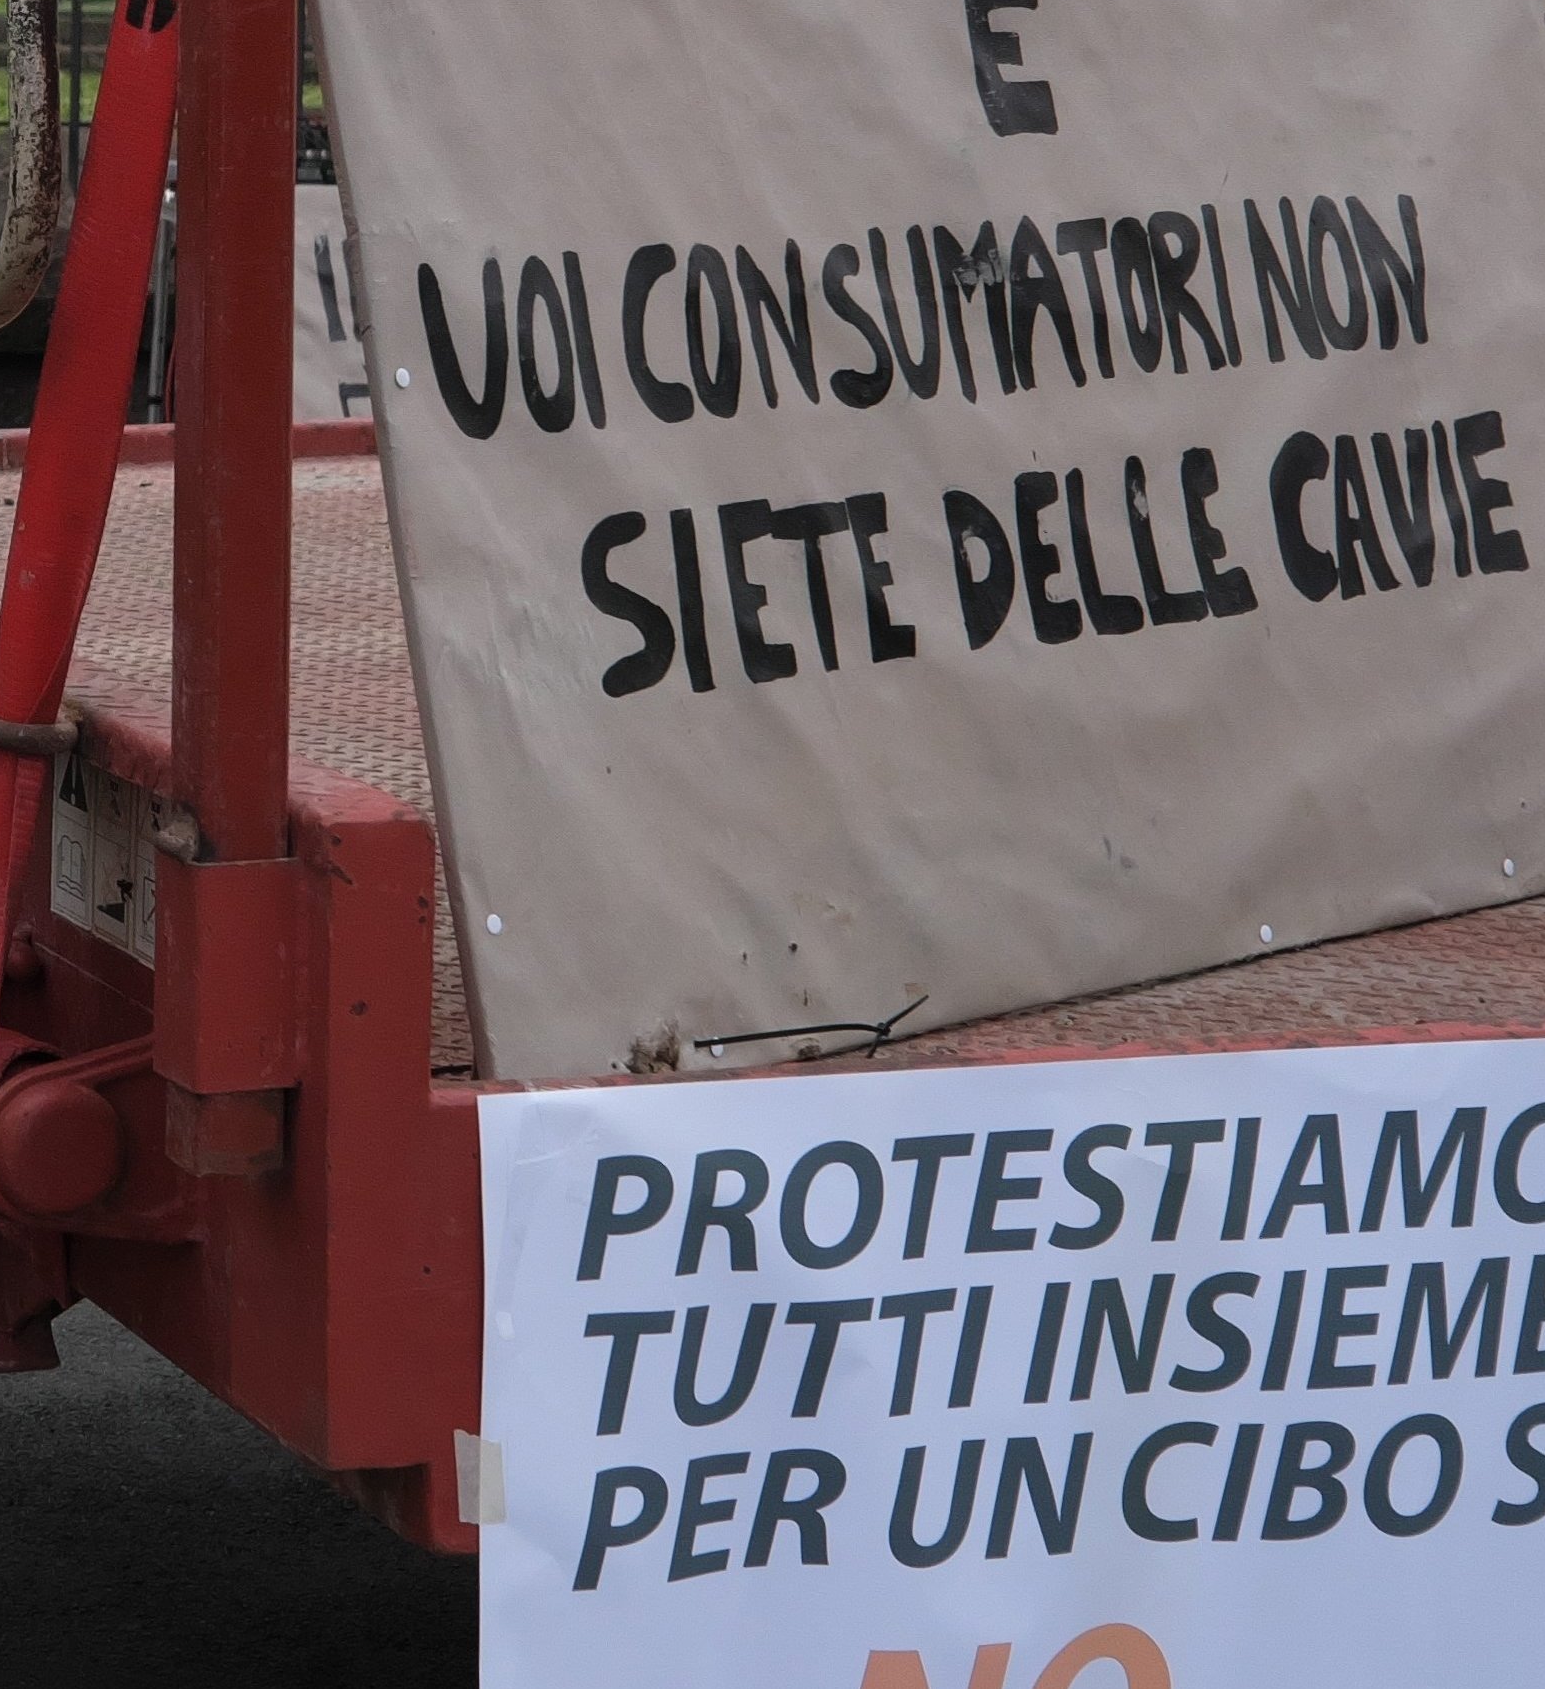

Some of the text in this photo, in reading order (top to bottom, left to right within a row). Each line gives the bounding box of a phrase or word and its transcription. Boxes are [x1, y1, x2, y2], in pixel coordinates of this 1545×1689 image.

[621, 204, 1243, 423] CONSUMATORI
[1244, 195, 1428, 363] NON
[581, 410, 1529, 698] SIETE DELLE CAVIE
[584, 1286, 993, 1436] TUTTI
[572, 1448, 846, 1591] PER
[889, 1432, 1093, 1568] UN
[1122, 1413, 1463, 1542] CIBO
